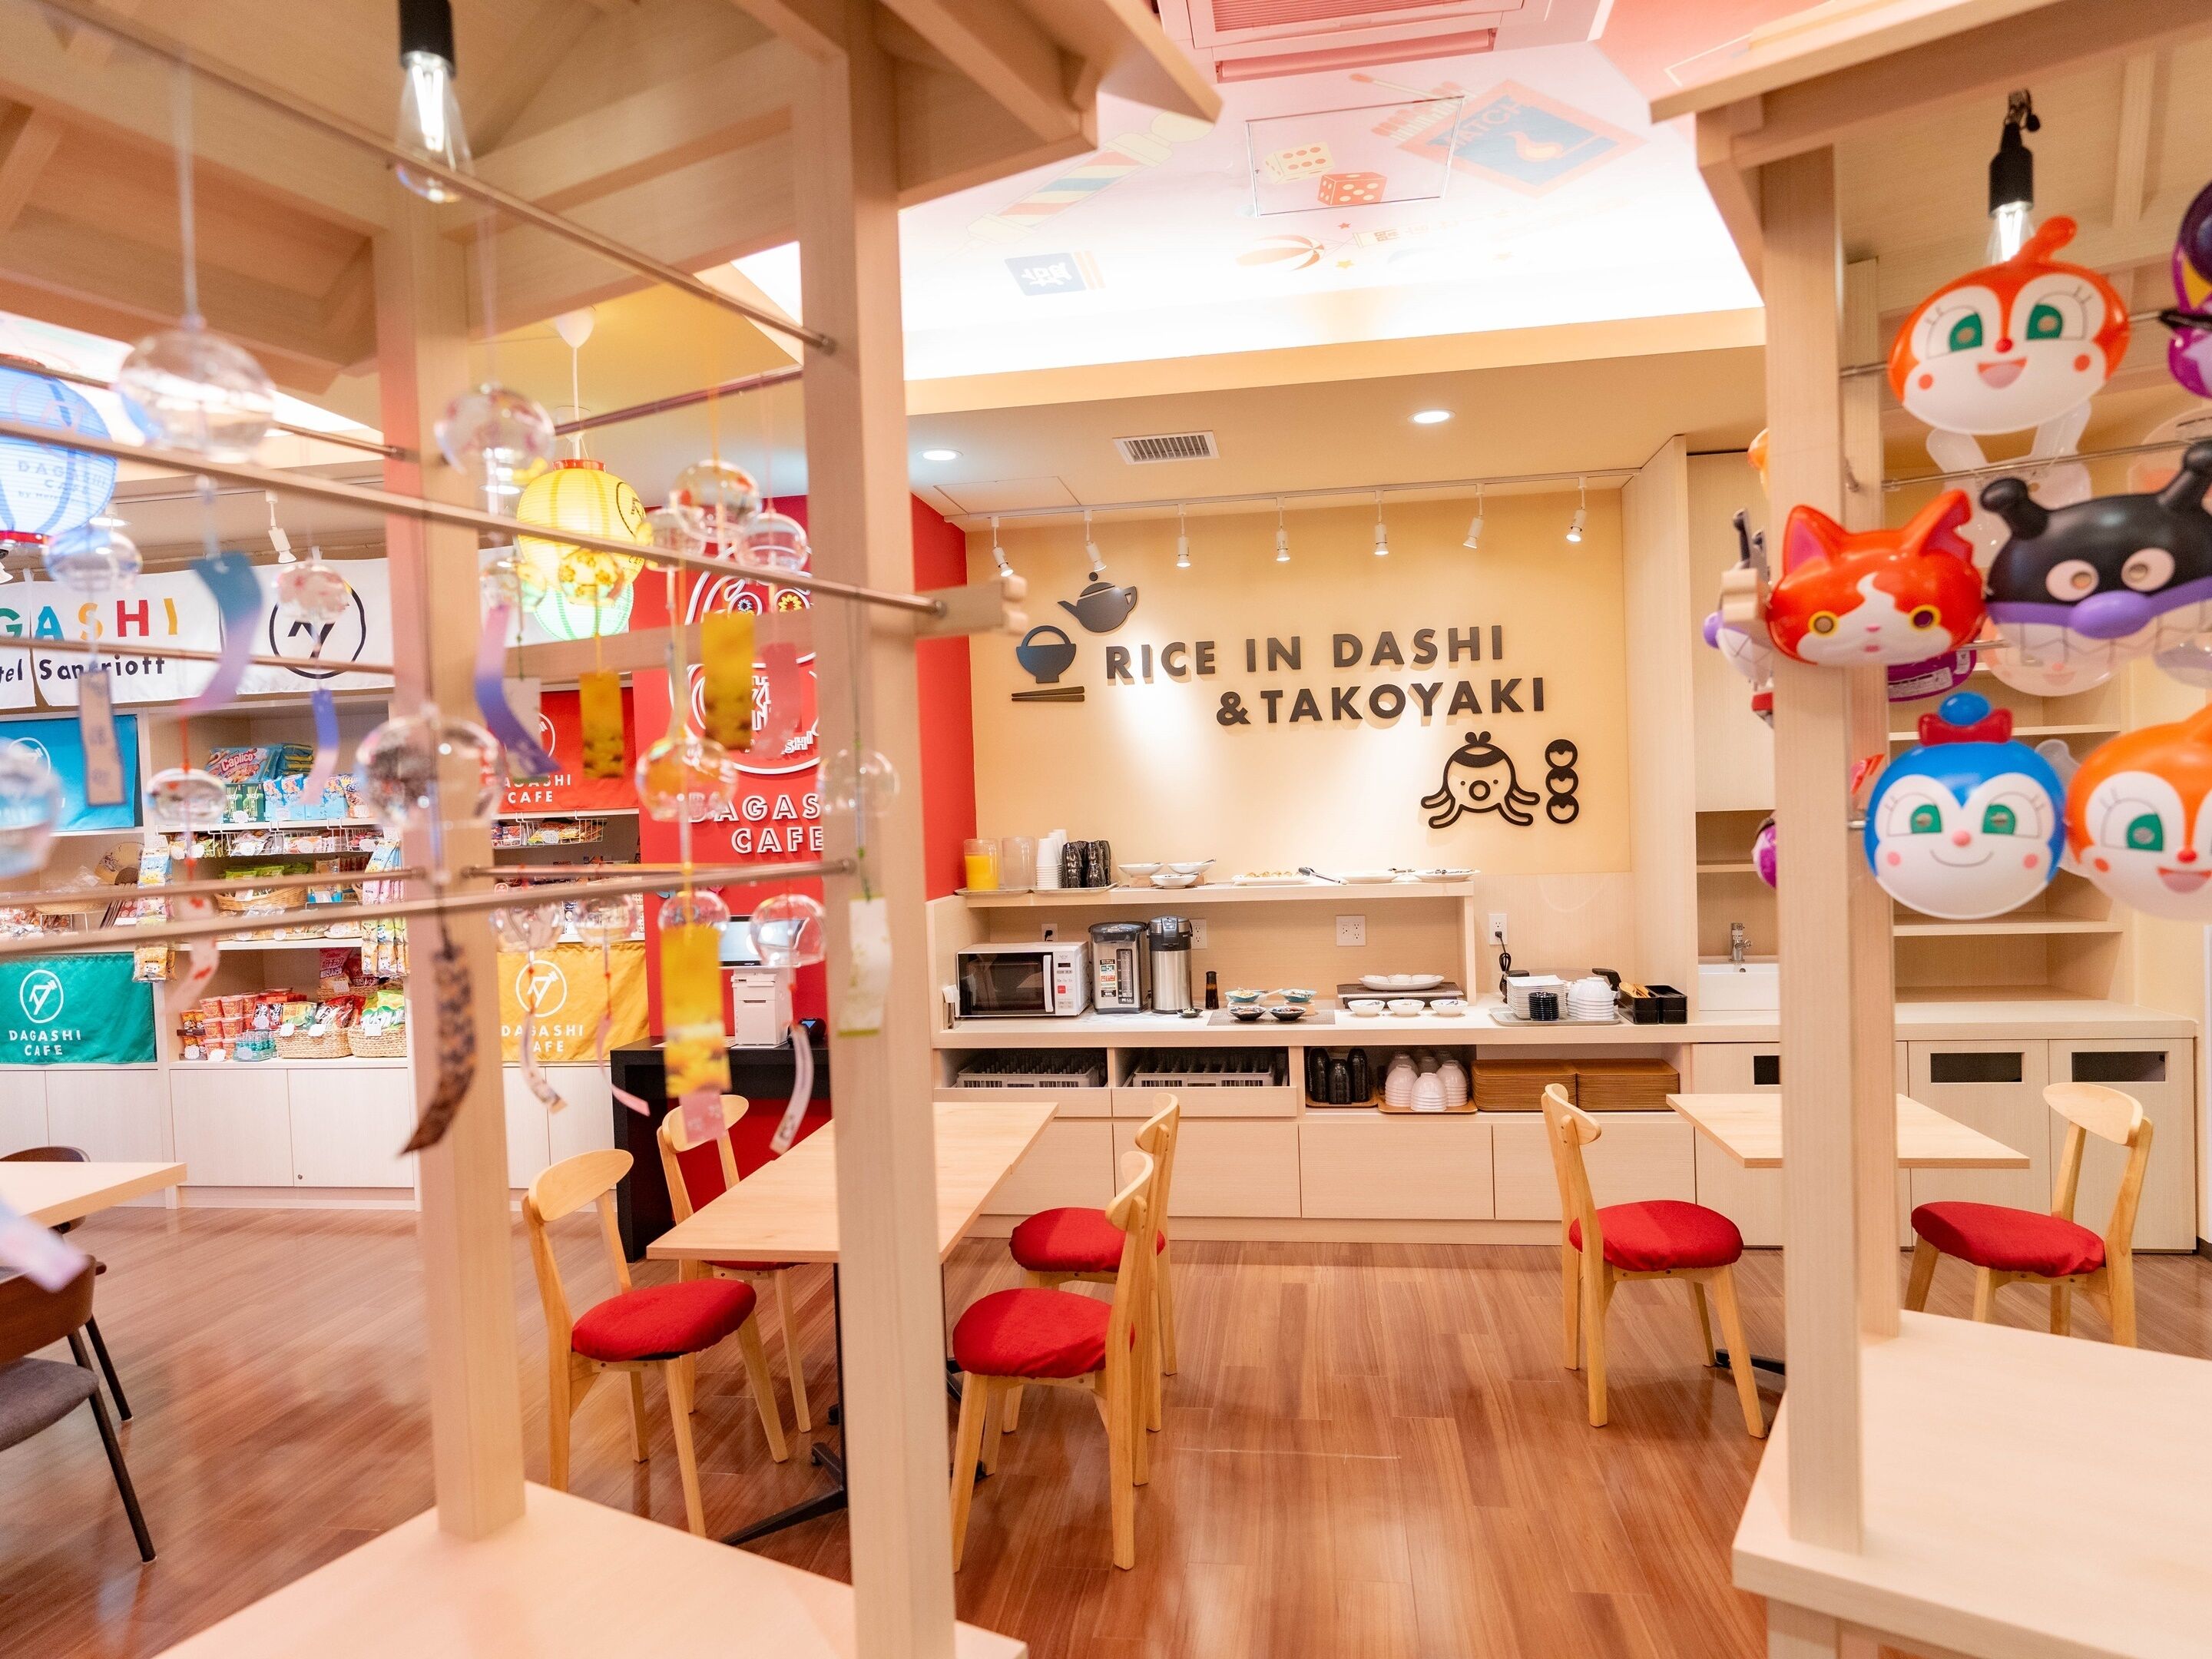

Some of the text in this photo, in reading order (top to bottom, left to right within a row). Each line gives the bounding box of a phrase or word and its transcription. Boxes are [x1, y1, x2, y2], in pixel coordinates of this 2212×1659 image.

[1105, 625, 1504, 680] RICE IN DASHI
[39, 654, 165, 680] Sanriott
[221, 753, 253, 772] Caplico
[507, 791, 553, 803] CAFE
[688, 791, 820, 823] DAGAS
[730, 826, 824, 854] CAFE
[8, 1029, 81, 1041] DAGASHI
[24, 1045, 63, 1056] CAFE
[533, 1041, 565, 1052] AFE
